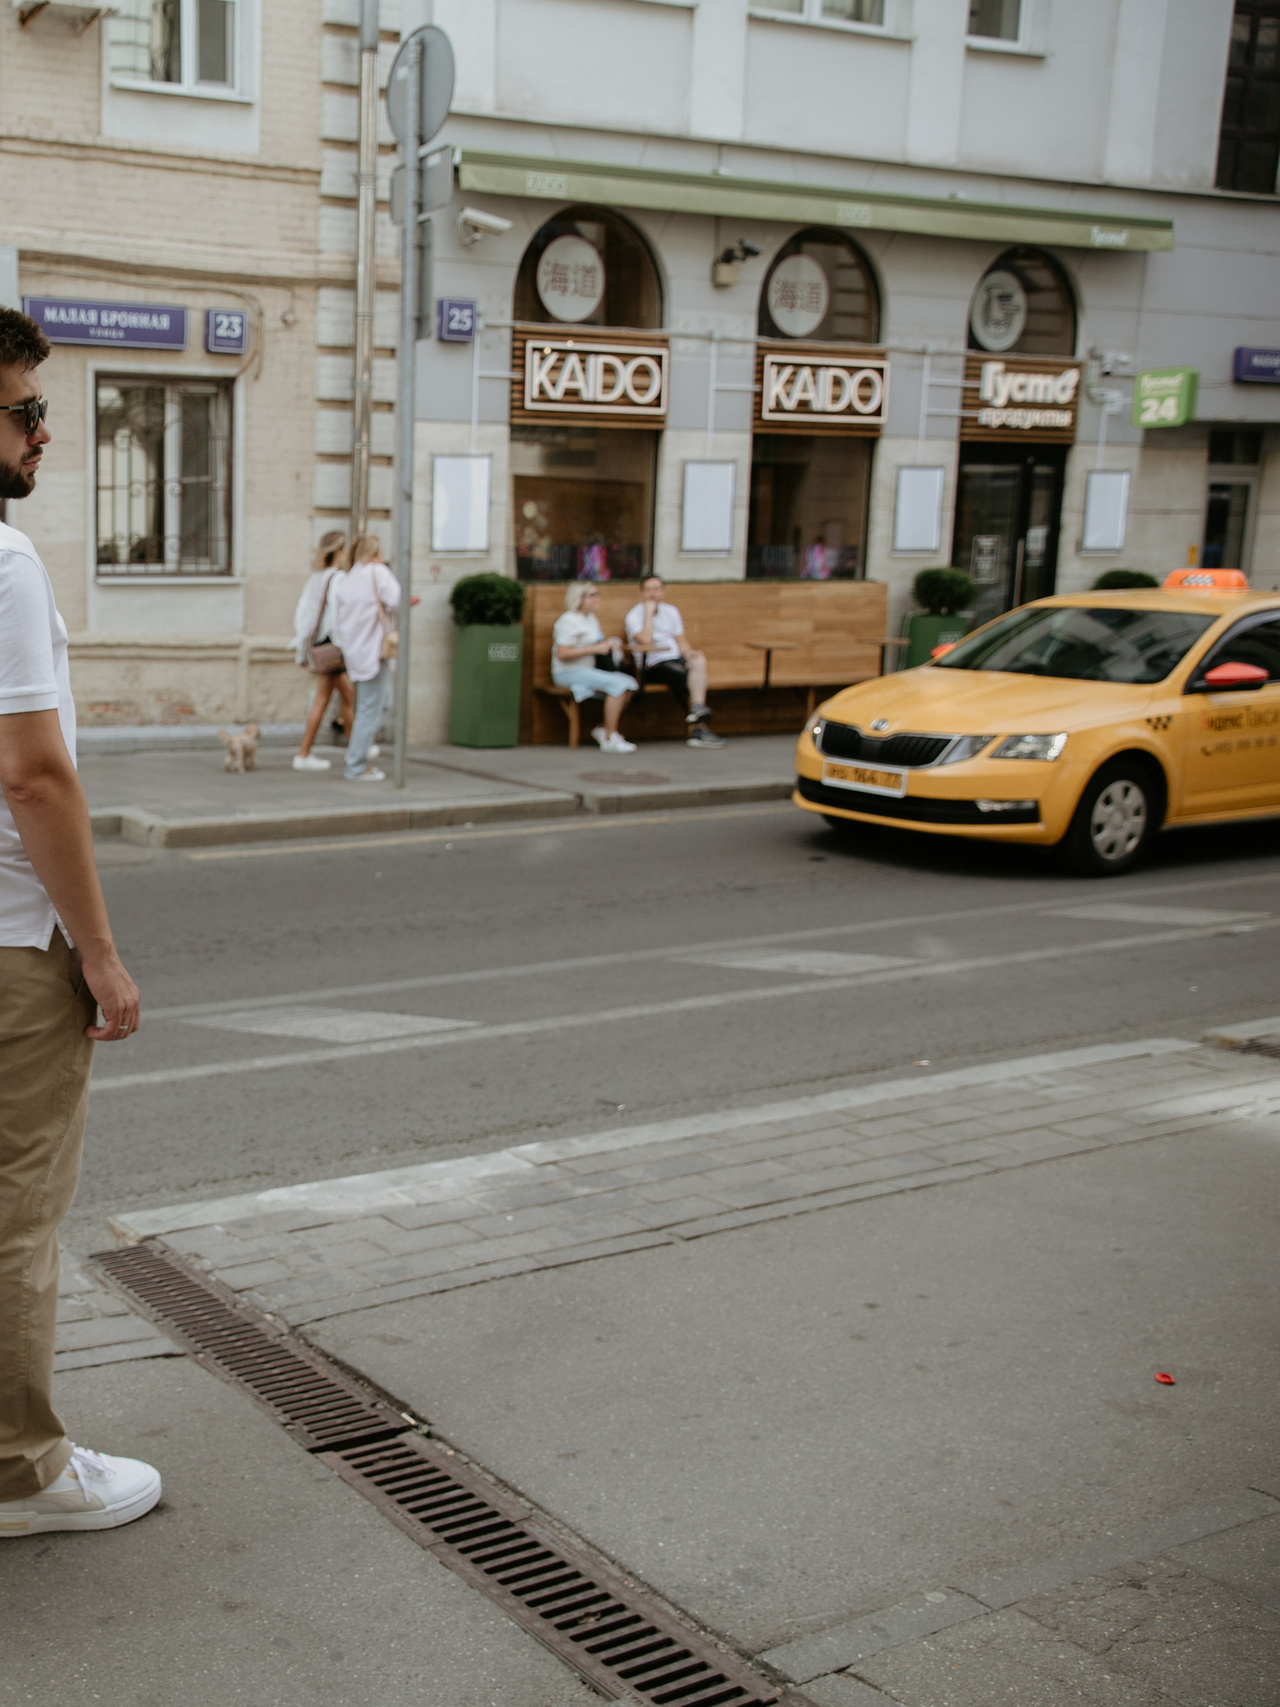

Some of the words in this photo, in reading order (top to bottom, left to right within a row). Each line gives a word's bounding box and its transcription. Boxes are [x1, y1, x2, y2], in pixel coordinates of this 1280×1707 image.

[44, 306, 98, 326] МАЛАЯ
[101, 310, 170, 331] БРОННАЯ
[215, 315, 242, 338] 23
[449, 307, 472, 331] 25
[532, 350, 661, 404] KAIDO
[769, 365, 882, 414] KAIDO
[1140, 396, 1178, 421] 24
